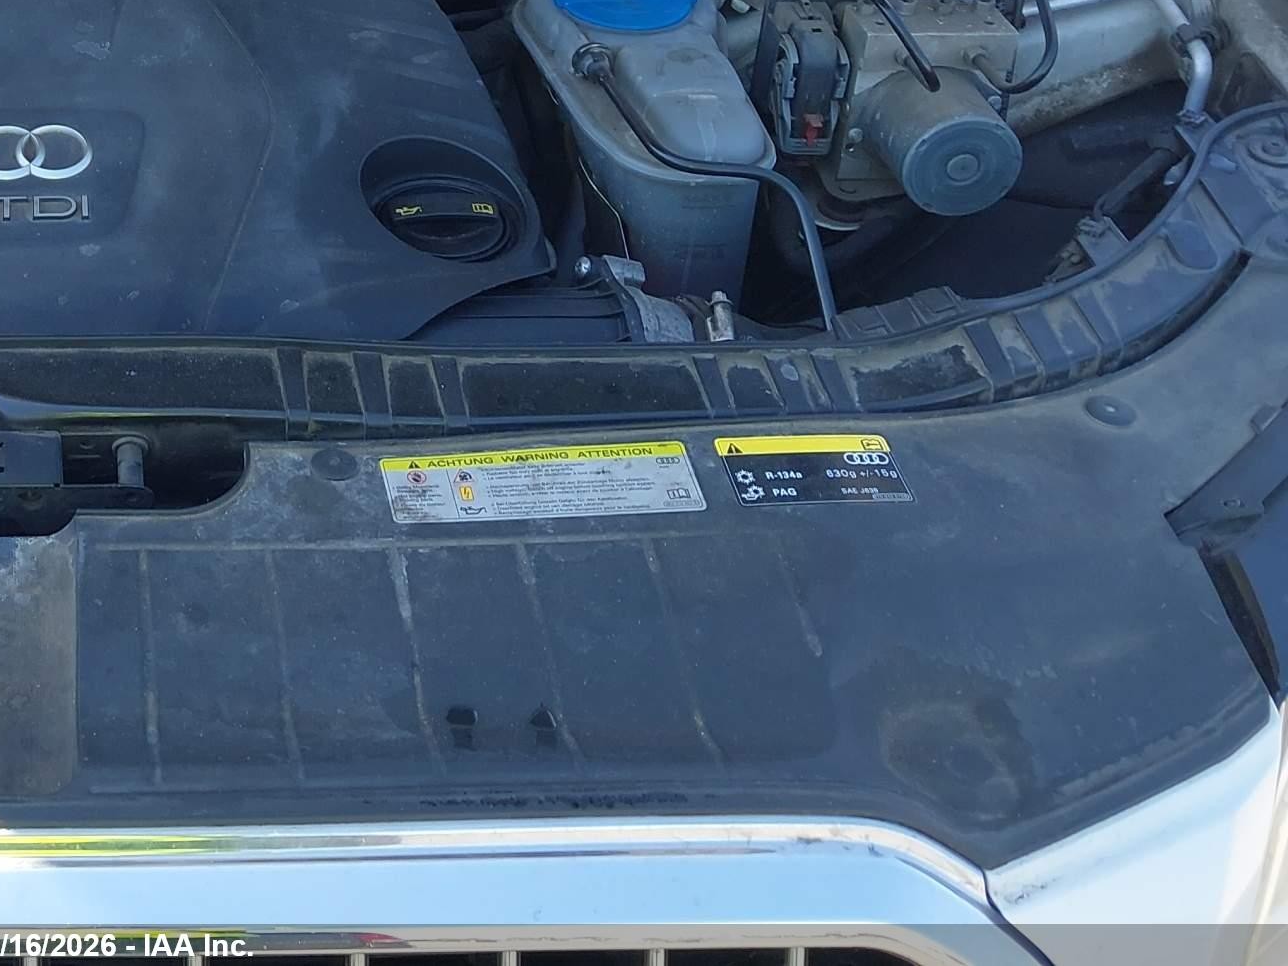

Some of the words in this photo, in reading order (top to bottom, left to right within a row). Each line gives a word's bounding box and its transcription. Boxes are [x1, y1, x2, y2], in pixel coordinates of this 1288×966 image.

[427, 456, 495, 468] ACHTUNG
[500, 452, 569, 463] WARNING
[577, 447, 653, 459] ATTENTION
[764, 470, 803, 480] R-134a
[772, 487, 798, 497] PAG
